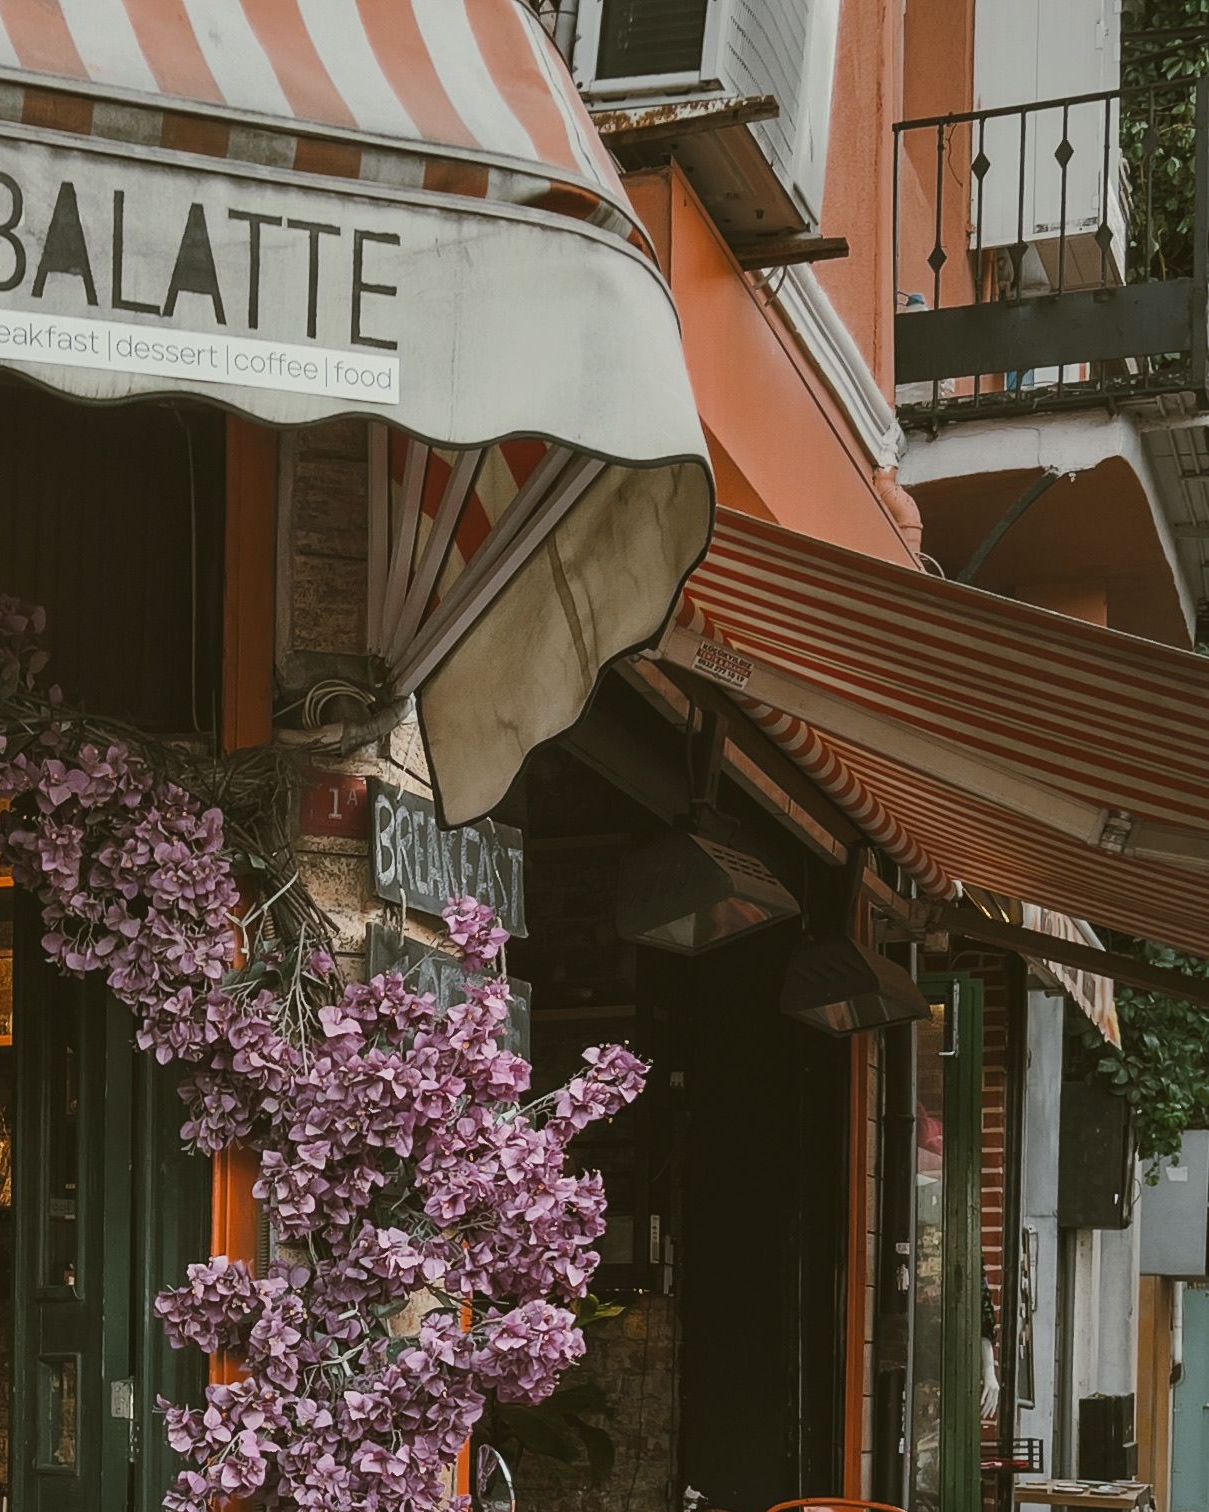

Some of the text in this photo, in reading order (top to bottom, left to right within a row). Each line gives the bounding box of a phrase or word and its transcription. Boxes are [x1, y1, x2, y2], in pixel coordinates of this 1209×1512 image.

[116, 335, 218, 369] dessert
[234, 348, 319, 382] coffee
[333, 360, 393, 391] food
[375, 795, 524, 927] BREAKFAST
